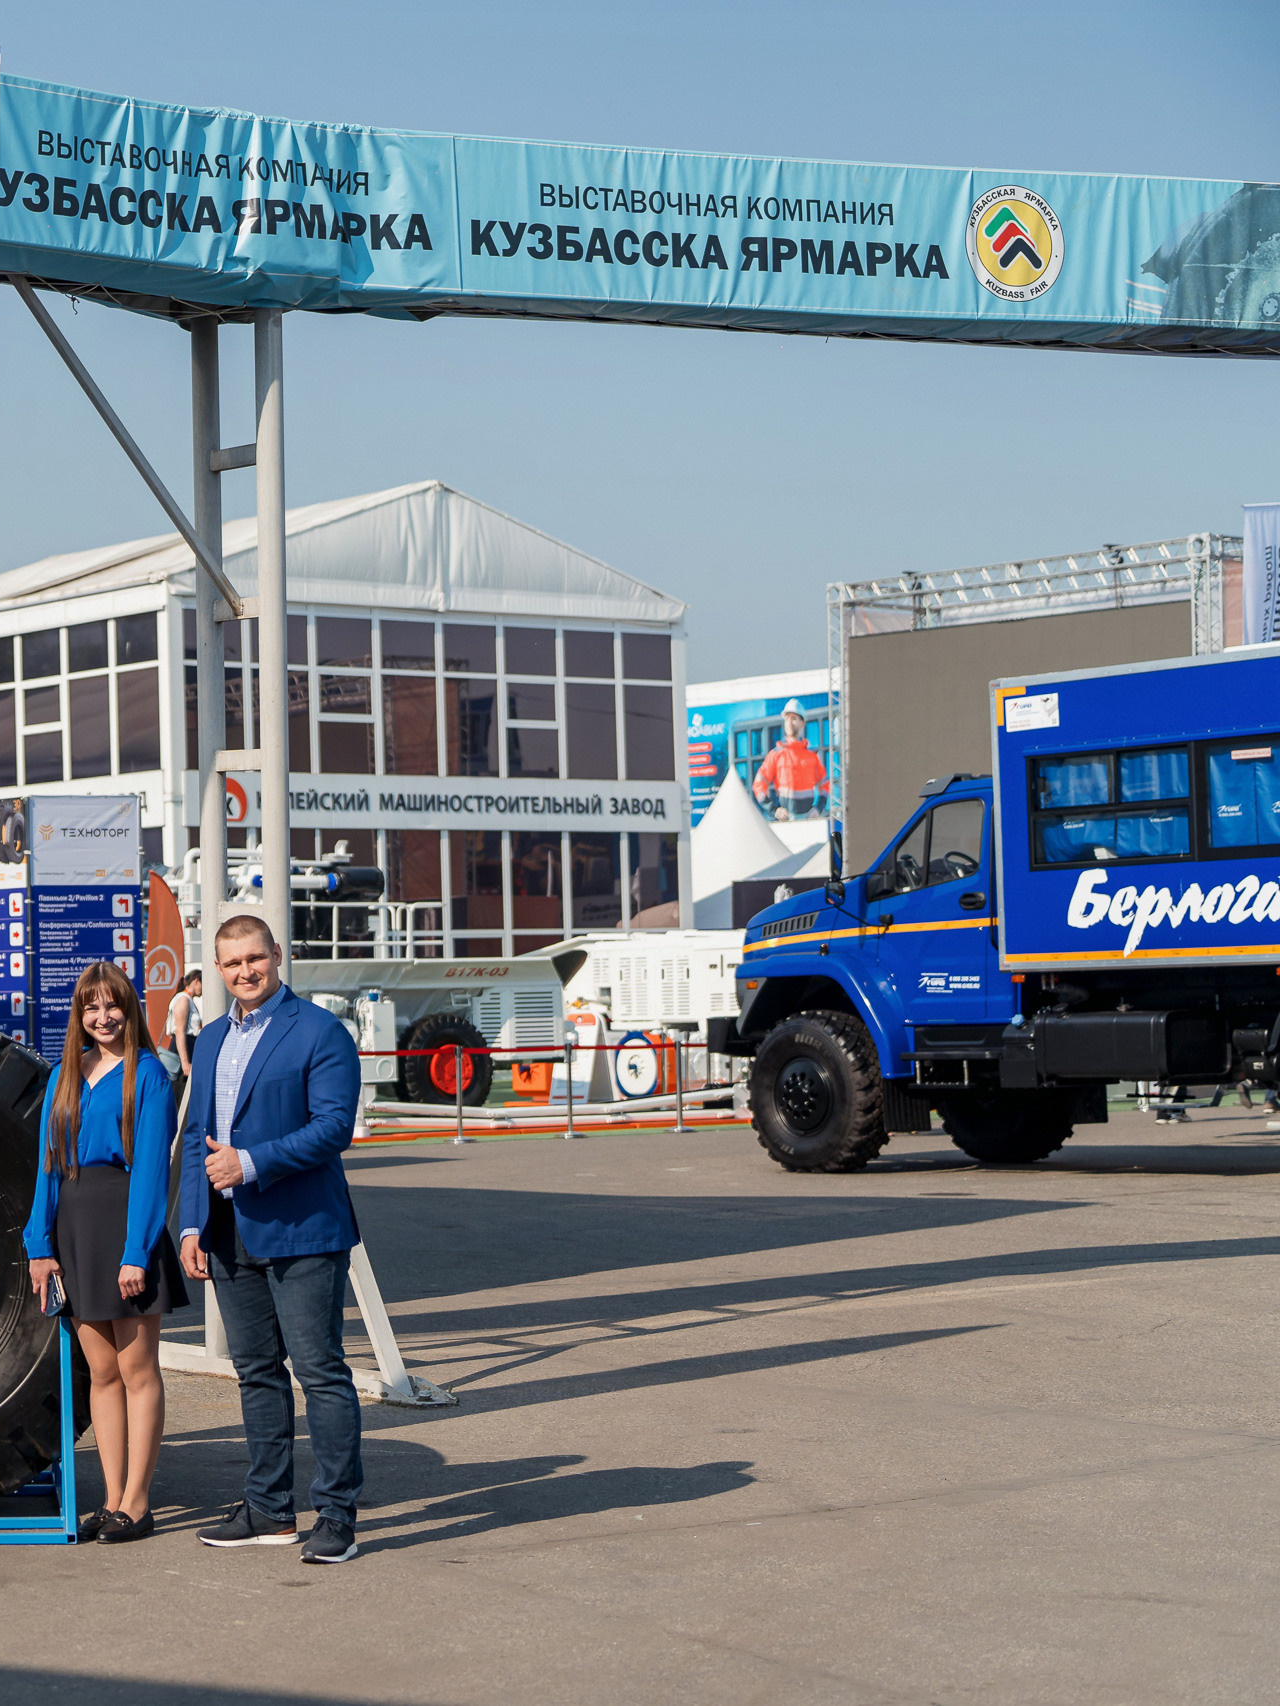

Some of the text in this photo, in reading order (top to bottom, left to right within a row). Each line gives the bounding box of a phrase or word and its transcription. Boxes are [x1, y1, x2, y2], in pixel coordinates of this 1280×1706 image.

[37, 130, 370, 196] ВЫСТАВОЧНАЯ КОМПАНИЯ
[232, 198, 433, 251] ЯРМАРКА
[540, 182, 894, 226] ВЫСТАВОЧНАЯ КОМПАНИЯ
[970, 188, 1059, 231] КУЗБАССКАЯ ЯРМАРКА
[471, 220, 950, 279] КУЗБАССКА ЯРМАРКА
[985, 279, 1049, 299] KUZBASS FAIR
[256, 789, 665, 819] ЕЙСКИЙ МАШИНОСТРОИТЕЛЬНЫЙ ЗАВОД
[61, 828, 129, 838] ТЕХНОТОРГ
[1067, 868, 1280, 958] Берлога
